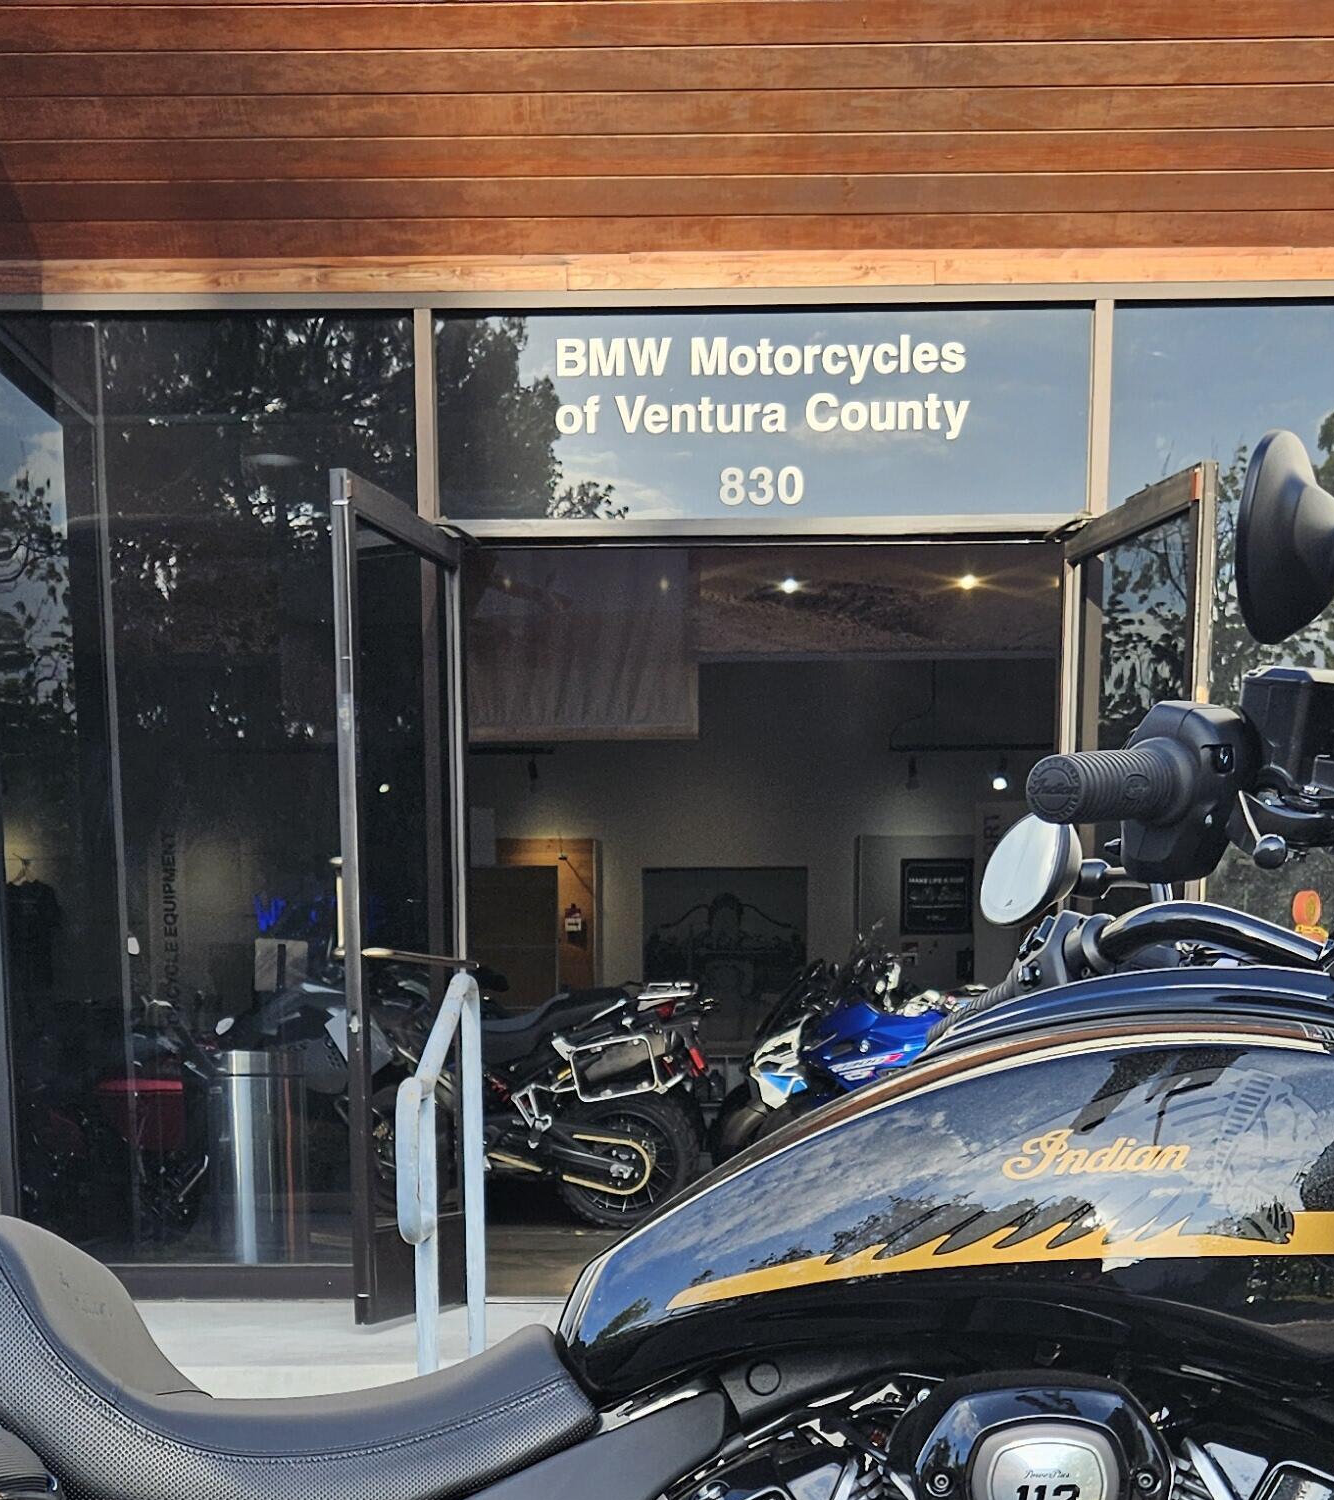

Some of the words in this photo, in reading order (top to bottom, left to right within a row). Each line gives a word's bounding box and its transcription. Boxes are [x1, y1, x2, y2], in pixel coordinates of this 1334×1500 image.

[556, 337, 672, 377] BMW
[691, 334, 966, 384] Motorcycles
[555, 396, 600, 434] of
[616, 395, 787, 434] Ventura
[805, 392, 970, 439] County
[719, 466, 805, 505] 830
[1002, 1128, 1191, 1181] Indian
